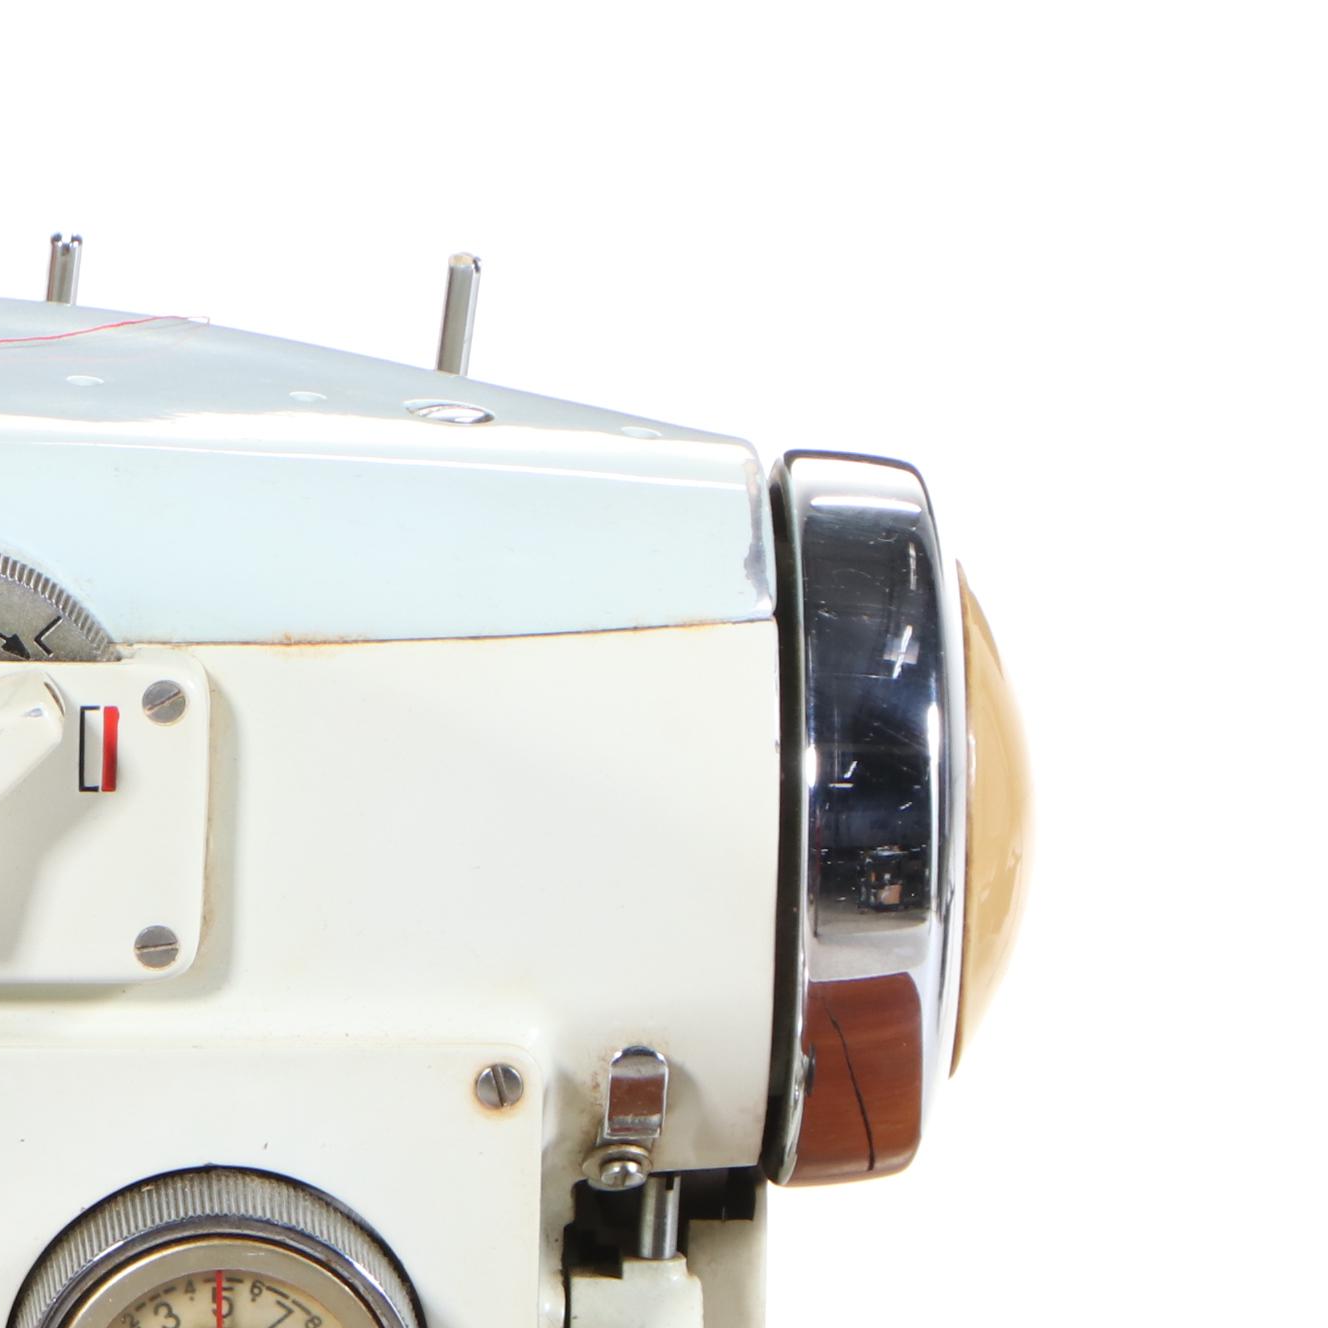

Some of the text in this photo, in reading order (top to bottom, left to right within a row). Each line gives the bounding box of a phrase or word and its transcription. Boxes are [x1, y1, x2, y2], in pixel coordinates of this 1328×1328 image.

[34, 614, 65, 657] L
[183, 1278, 197, 1297] 4
[210, 1285, 236, 1320] 5
[249, 1278, 265, 1298] 6
